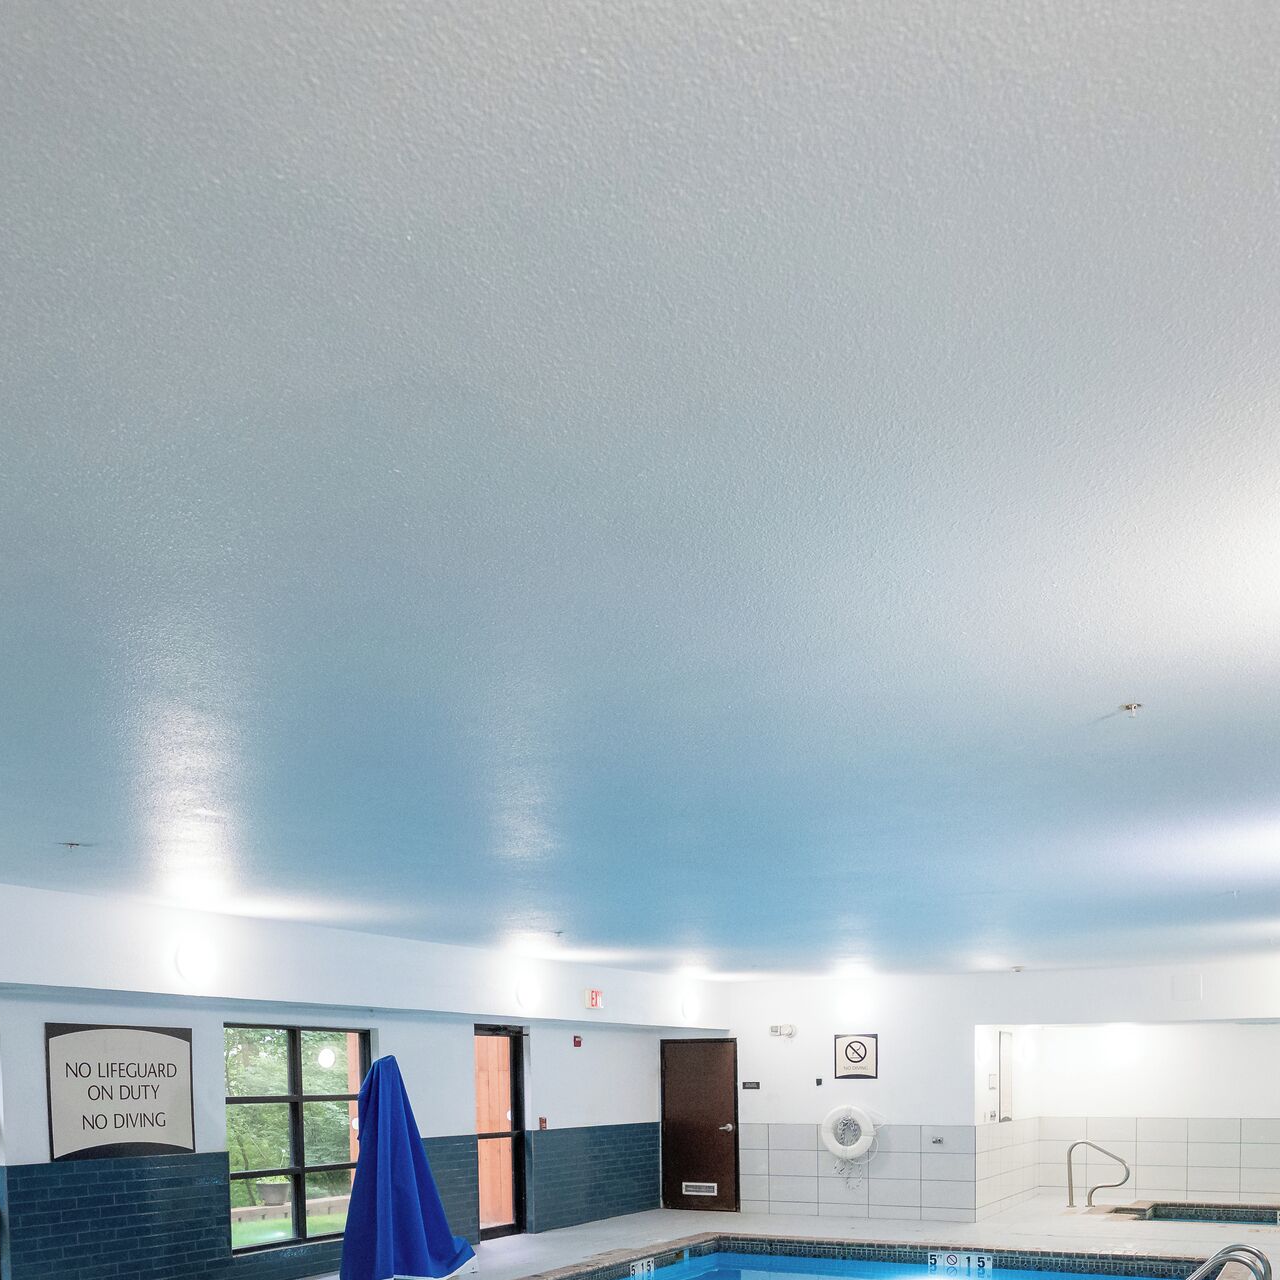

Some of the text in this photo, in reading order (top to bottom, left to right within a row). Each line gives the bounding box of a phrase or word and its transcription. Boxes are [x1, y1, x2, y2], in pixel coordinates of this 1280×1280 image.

[65, 1062, 177, 1078] NO LIFEGUARD
[87, 1084, 160, 1101] ON DUTY
[82, 1112, 166, 1130] NO DIVING
[929, 1254, 937, 1266] 5
[965, 1256, 971, 1267] 1
[977, 1256, 985, 1268] 5
